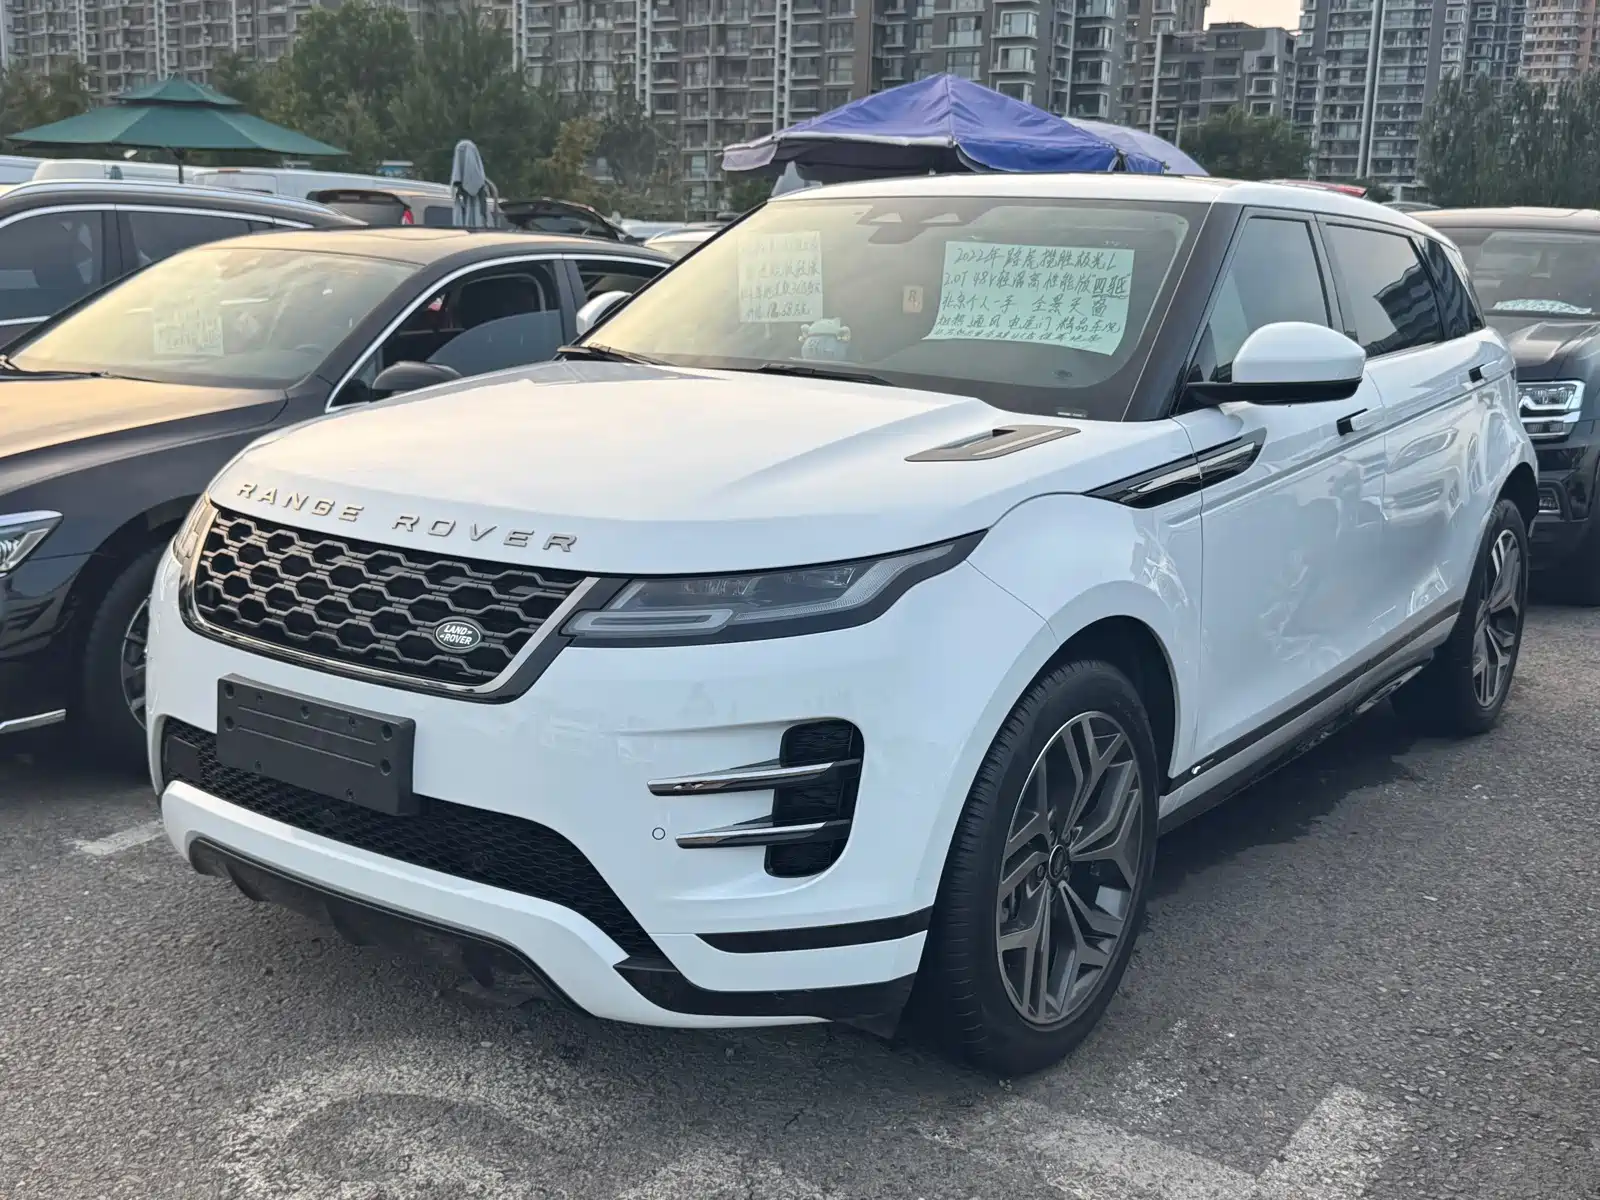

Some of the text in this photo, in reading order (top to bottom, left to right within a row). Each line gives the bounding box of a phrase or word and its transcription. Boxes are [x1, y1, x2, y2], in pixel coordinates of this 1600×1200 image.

[236, 483, 579, 552] RANGE ROVER
[443, 624, 469, 636] LAND
[443, 633, 473, 645] ROVER
